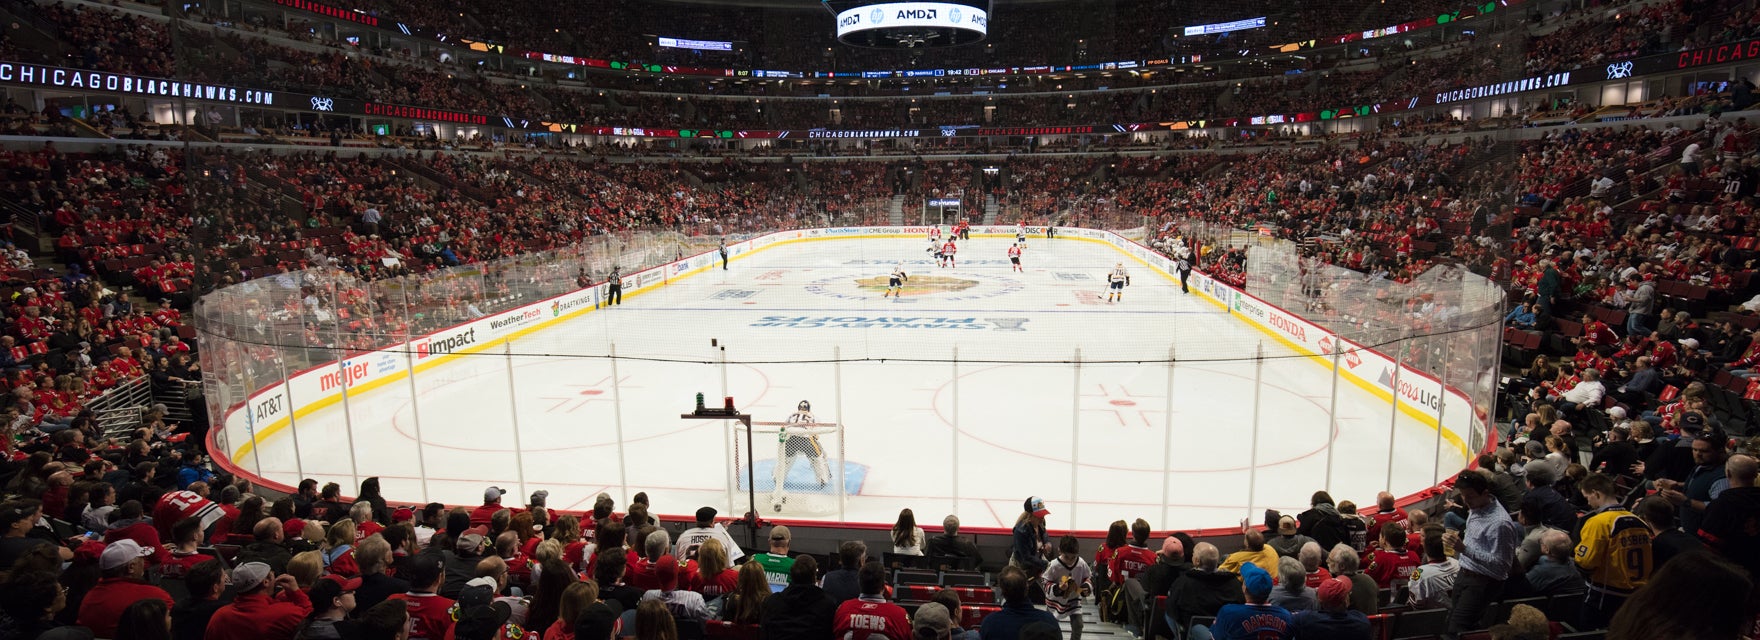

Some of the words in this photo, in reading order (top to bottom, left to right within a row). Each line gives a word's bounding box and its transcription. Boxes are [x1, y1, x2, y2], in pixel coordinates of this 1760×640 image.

[839, 16, 852, 28] AMD
[897, 9, 926, 19] AMD
[1362, 29, 1375, 39] ONE
[1435, 72, 1571, 104] CHICAGOBLACKHAWKS.COM
[365, 102, 487, 125] CHICAGOBLACKHAWKS.COM
[809, 130, 920, 138] CHICAGOBLACKHAWKS.COM
[887, 227, 900, 235] Group
[559, 295, 591, 312] DRAFTKINGS
[490, 308, 541, 330] WeatherTech
[1268, 311, 1307, 343] HONDA
[428, 328, 476, 356] impact
[319, 360, 369, 392] meijer
[1389, 368, 1419, 402] Coors
[256, 393, 282, 423] AT&T
[792, 413, 812, 424] 75
[1626, 547, 1644, 581] 9
[849, 613, 886, 632] TOEWS
[1241, 613, 1288, 634] DAWSON
